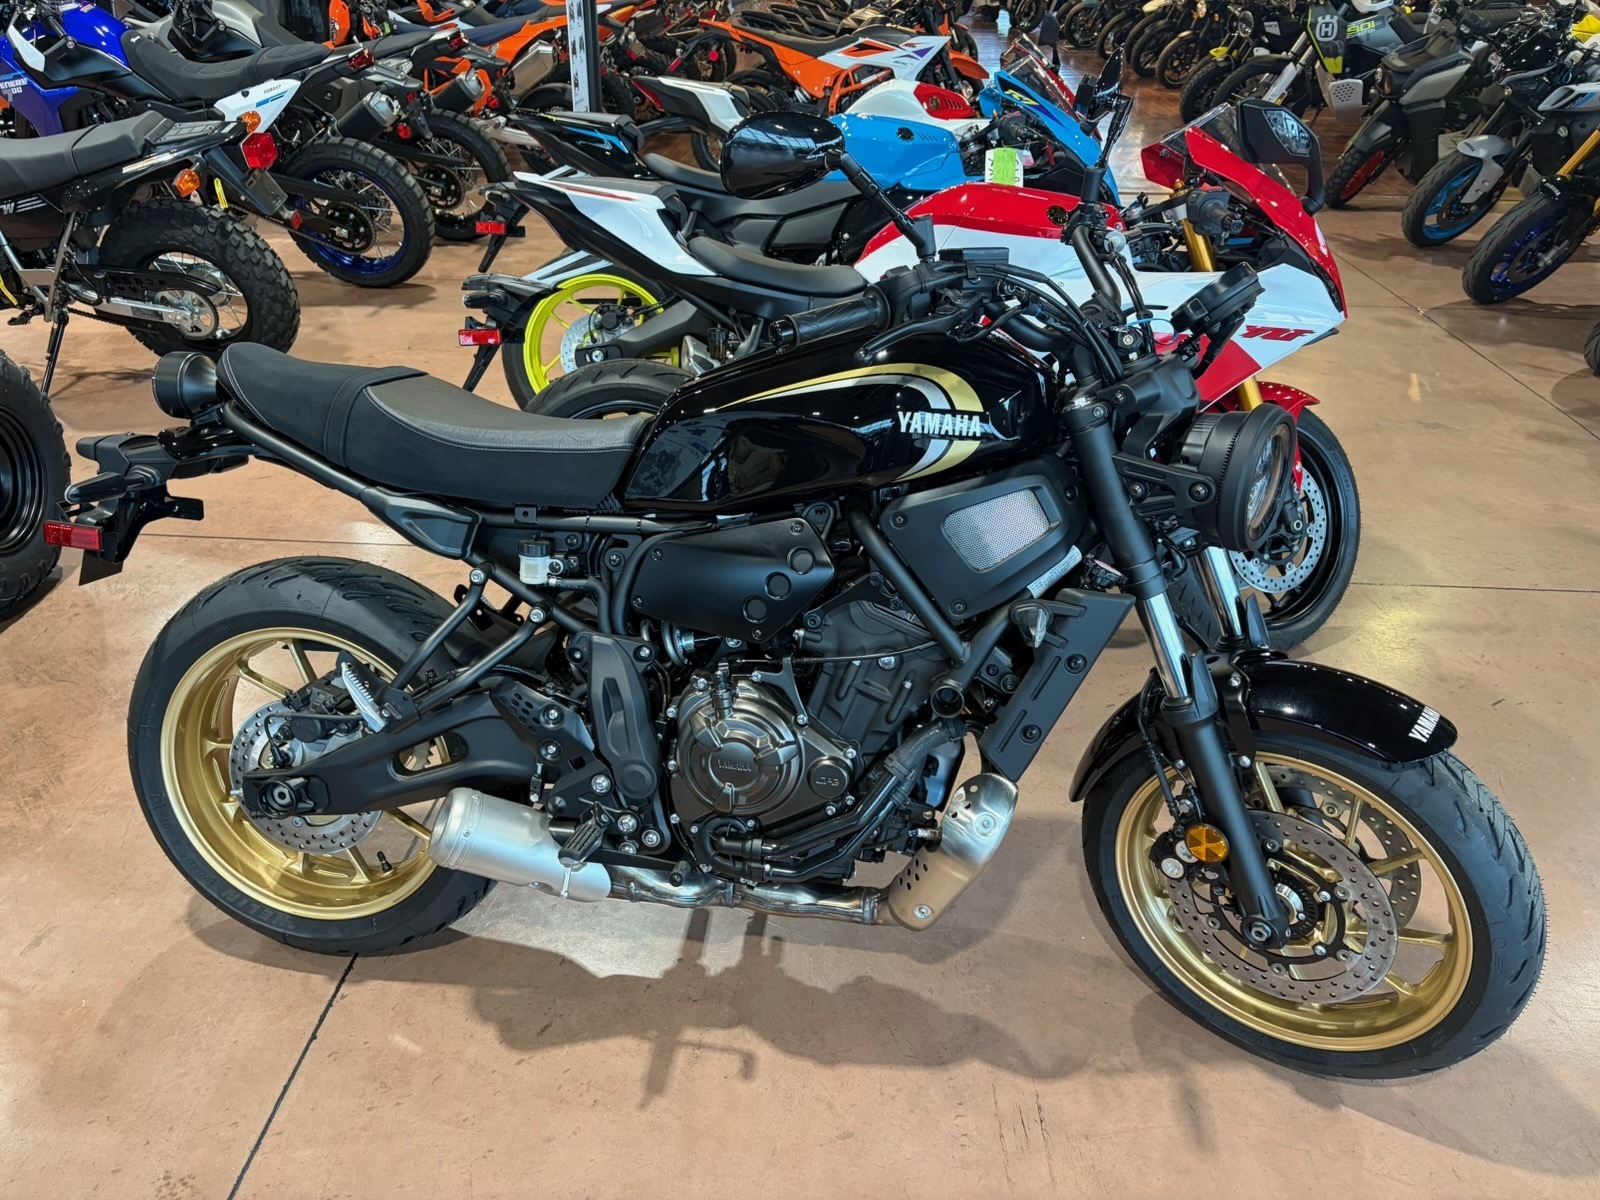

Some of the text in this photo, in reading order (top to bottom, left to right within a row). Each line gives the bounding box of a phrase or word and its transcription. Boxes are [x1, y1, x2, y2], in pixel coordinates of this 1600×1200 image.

[0, 77, 28, 90] ENERE
[1003, 89, 1040, 106] R7
[897, 410, 981, 437] YAMAHA
[717, 758, 752, 772] YAMAHA
